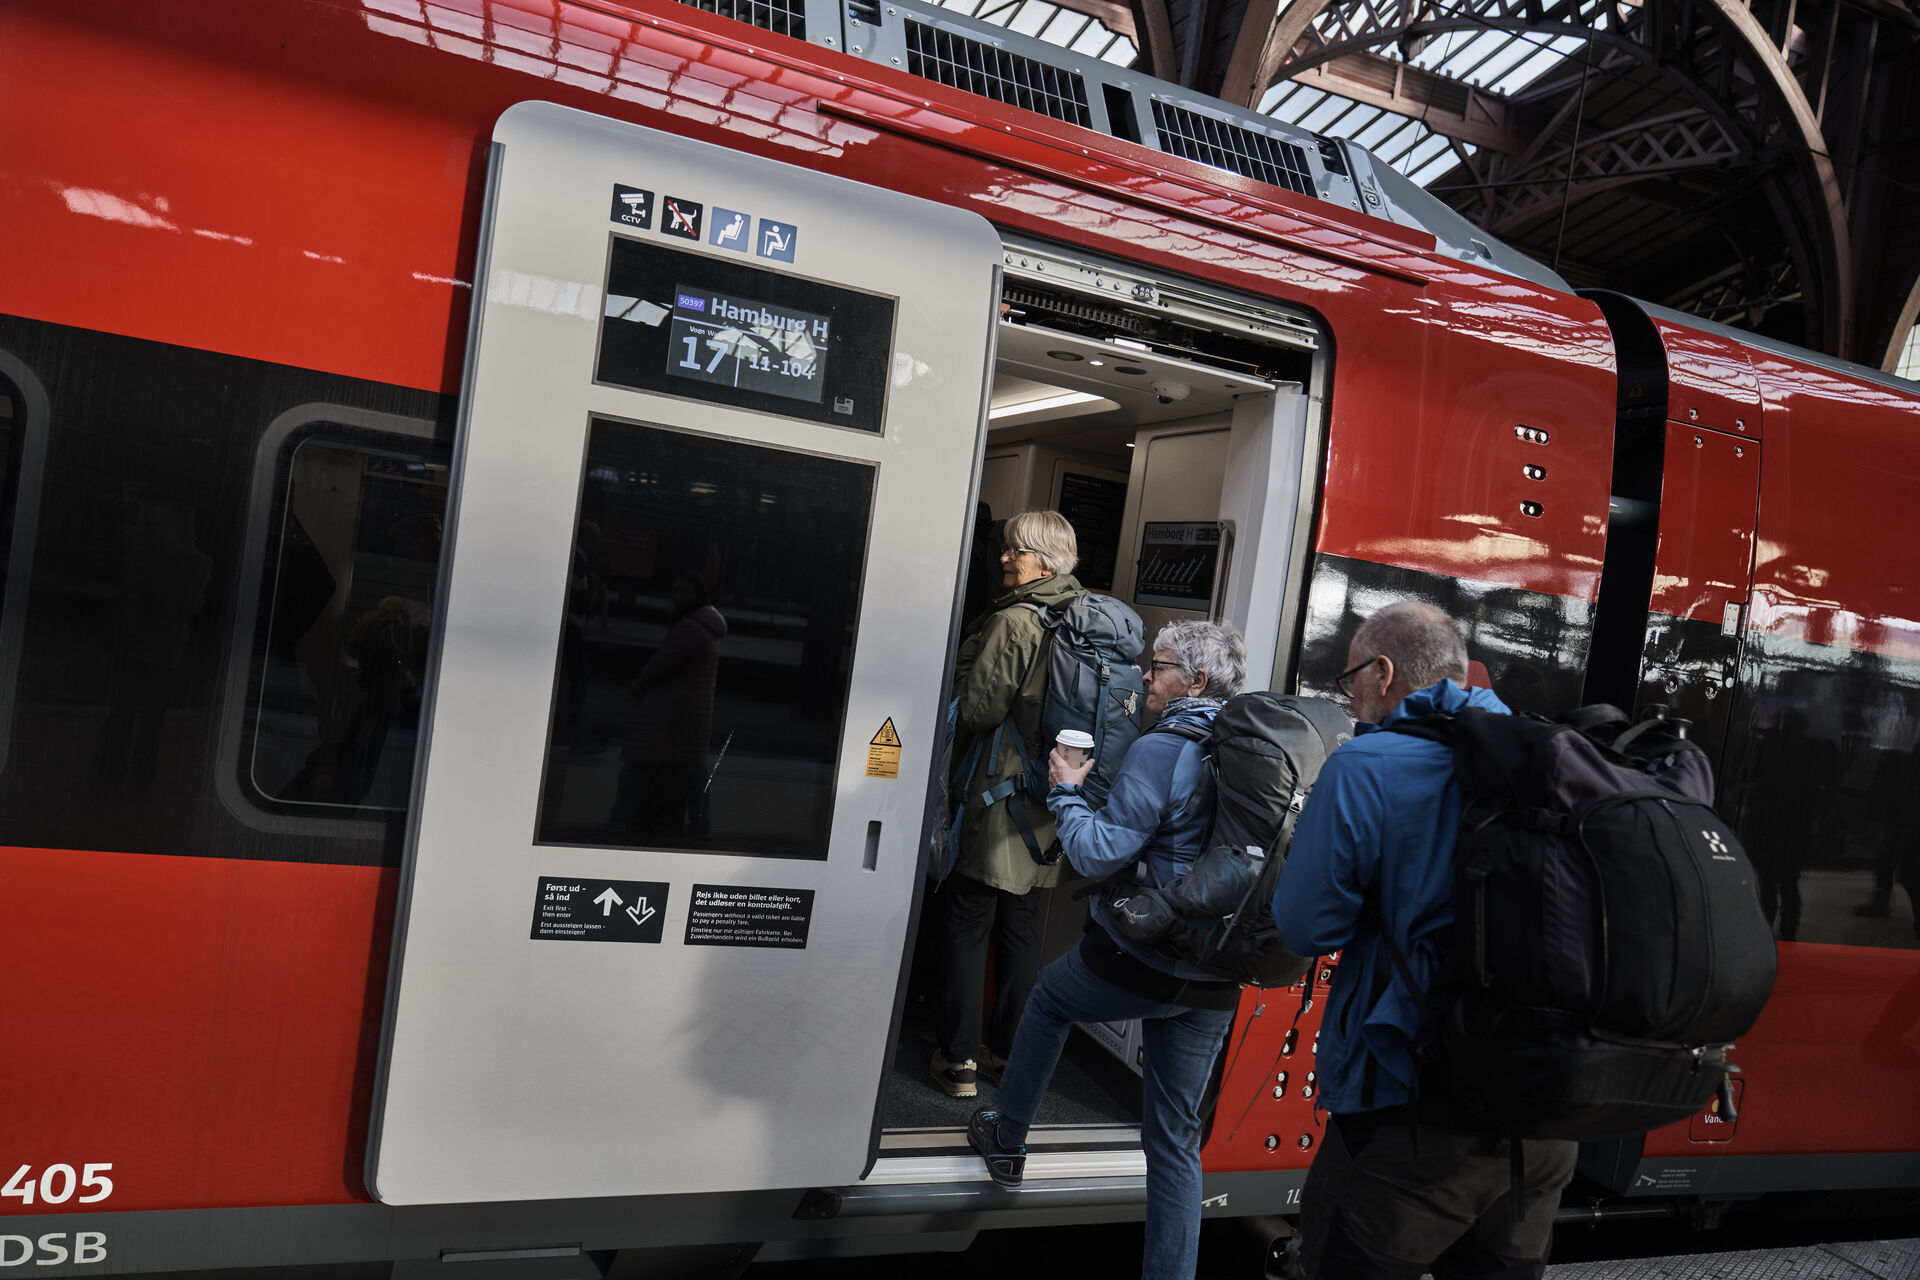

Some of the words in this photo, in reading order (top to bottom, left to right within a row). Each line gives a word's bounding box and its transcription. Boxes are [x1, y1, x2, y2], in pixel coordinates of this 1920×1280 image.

[621, 214, 641, 224] CCTV
[679, 297, 703, 308] 50397
[711, 298, 806, 335] Hamburg
[812, 320, 828, 339] H
[680, 336, 728, 374] 17
[750, 353, 815, 380] 11-104
[1187, 528, 1194, 538] H
[747, 901, 792, 910] kontrolafgift.
[0, 1163, 113, 1205] 405
[0, 1232, 107, 1267] DSB
